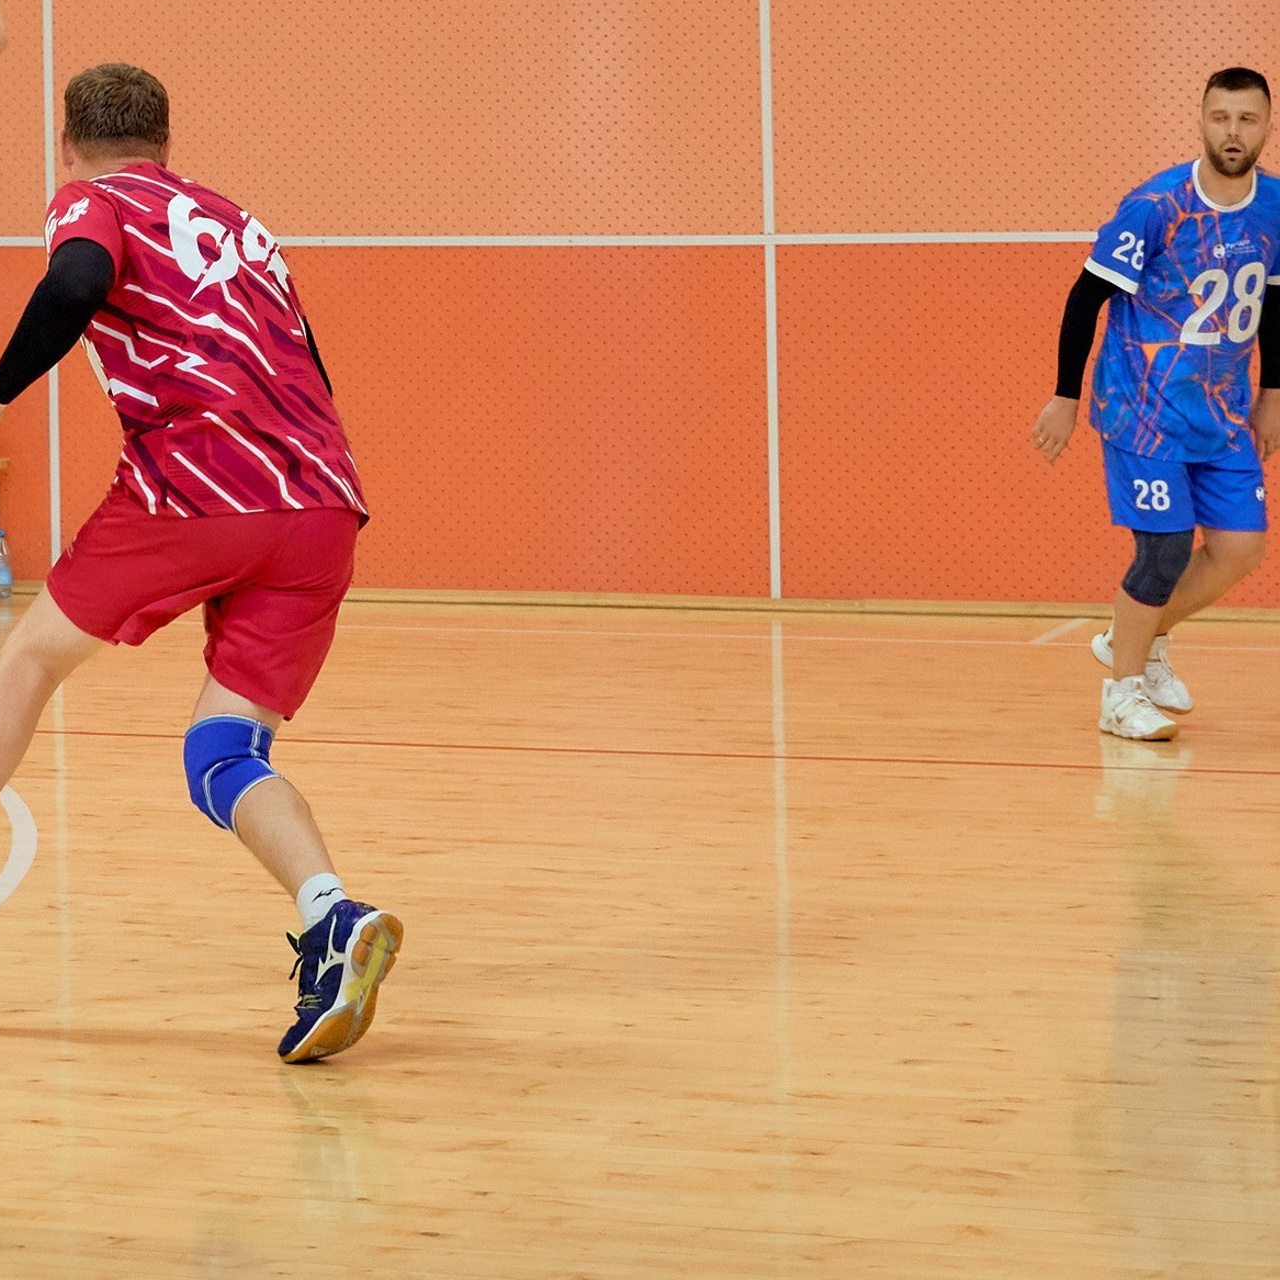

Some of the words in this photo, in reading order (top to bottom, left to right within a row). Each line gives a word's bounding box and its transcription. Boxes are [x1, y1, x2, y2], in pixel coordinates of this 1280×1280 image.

[1111, 231, 1145, 271] 28
[1179, 262, 1266, 345] 28
[1133, 479, 1171, 512] 28
